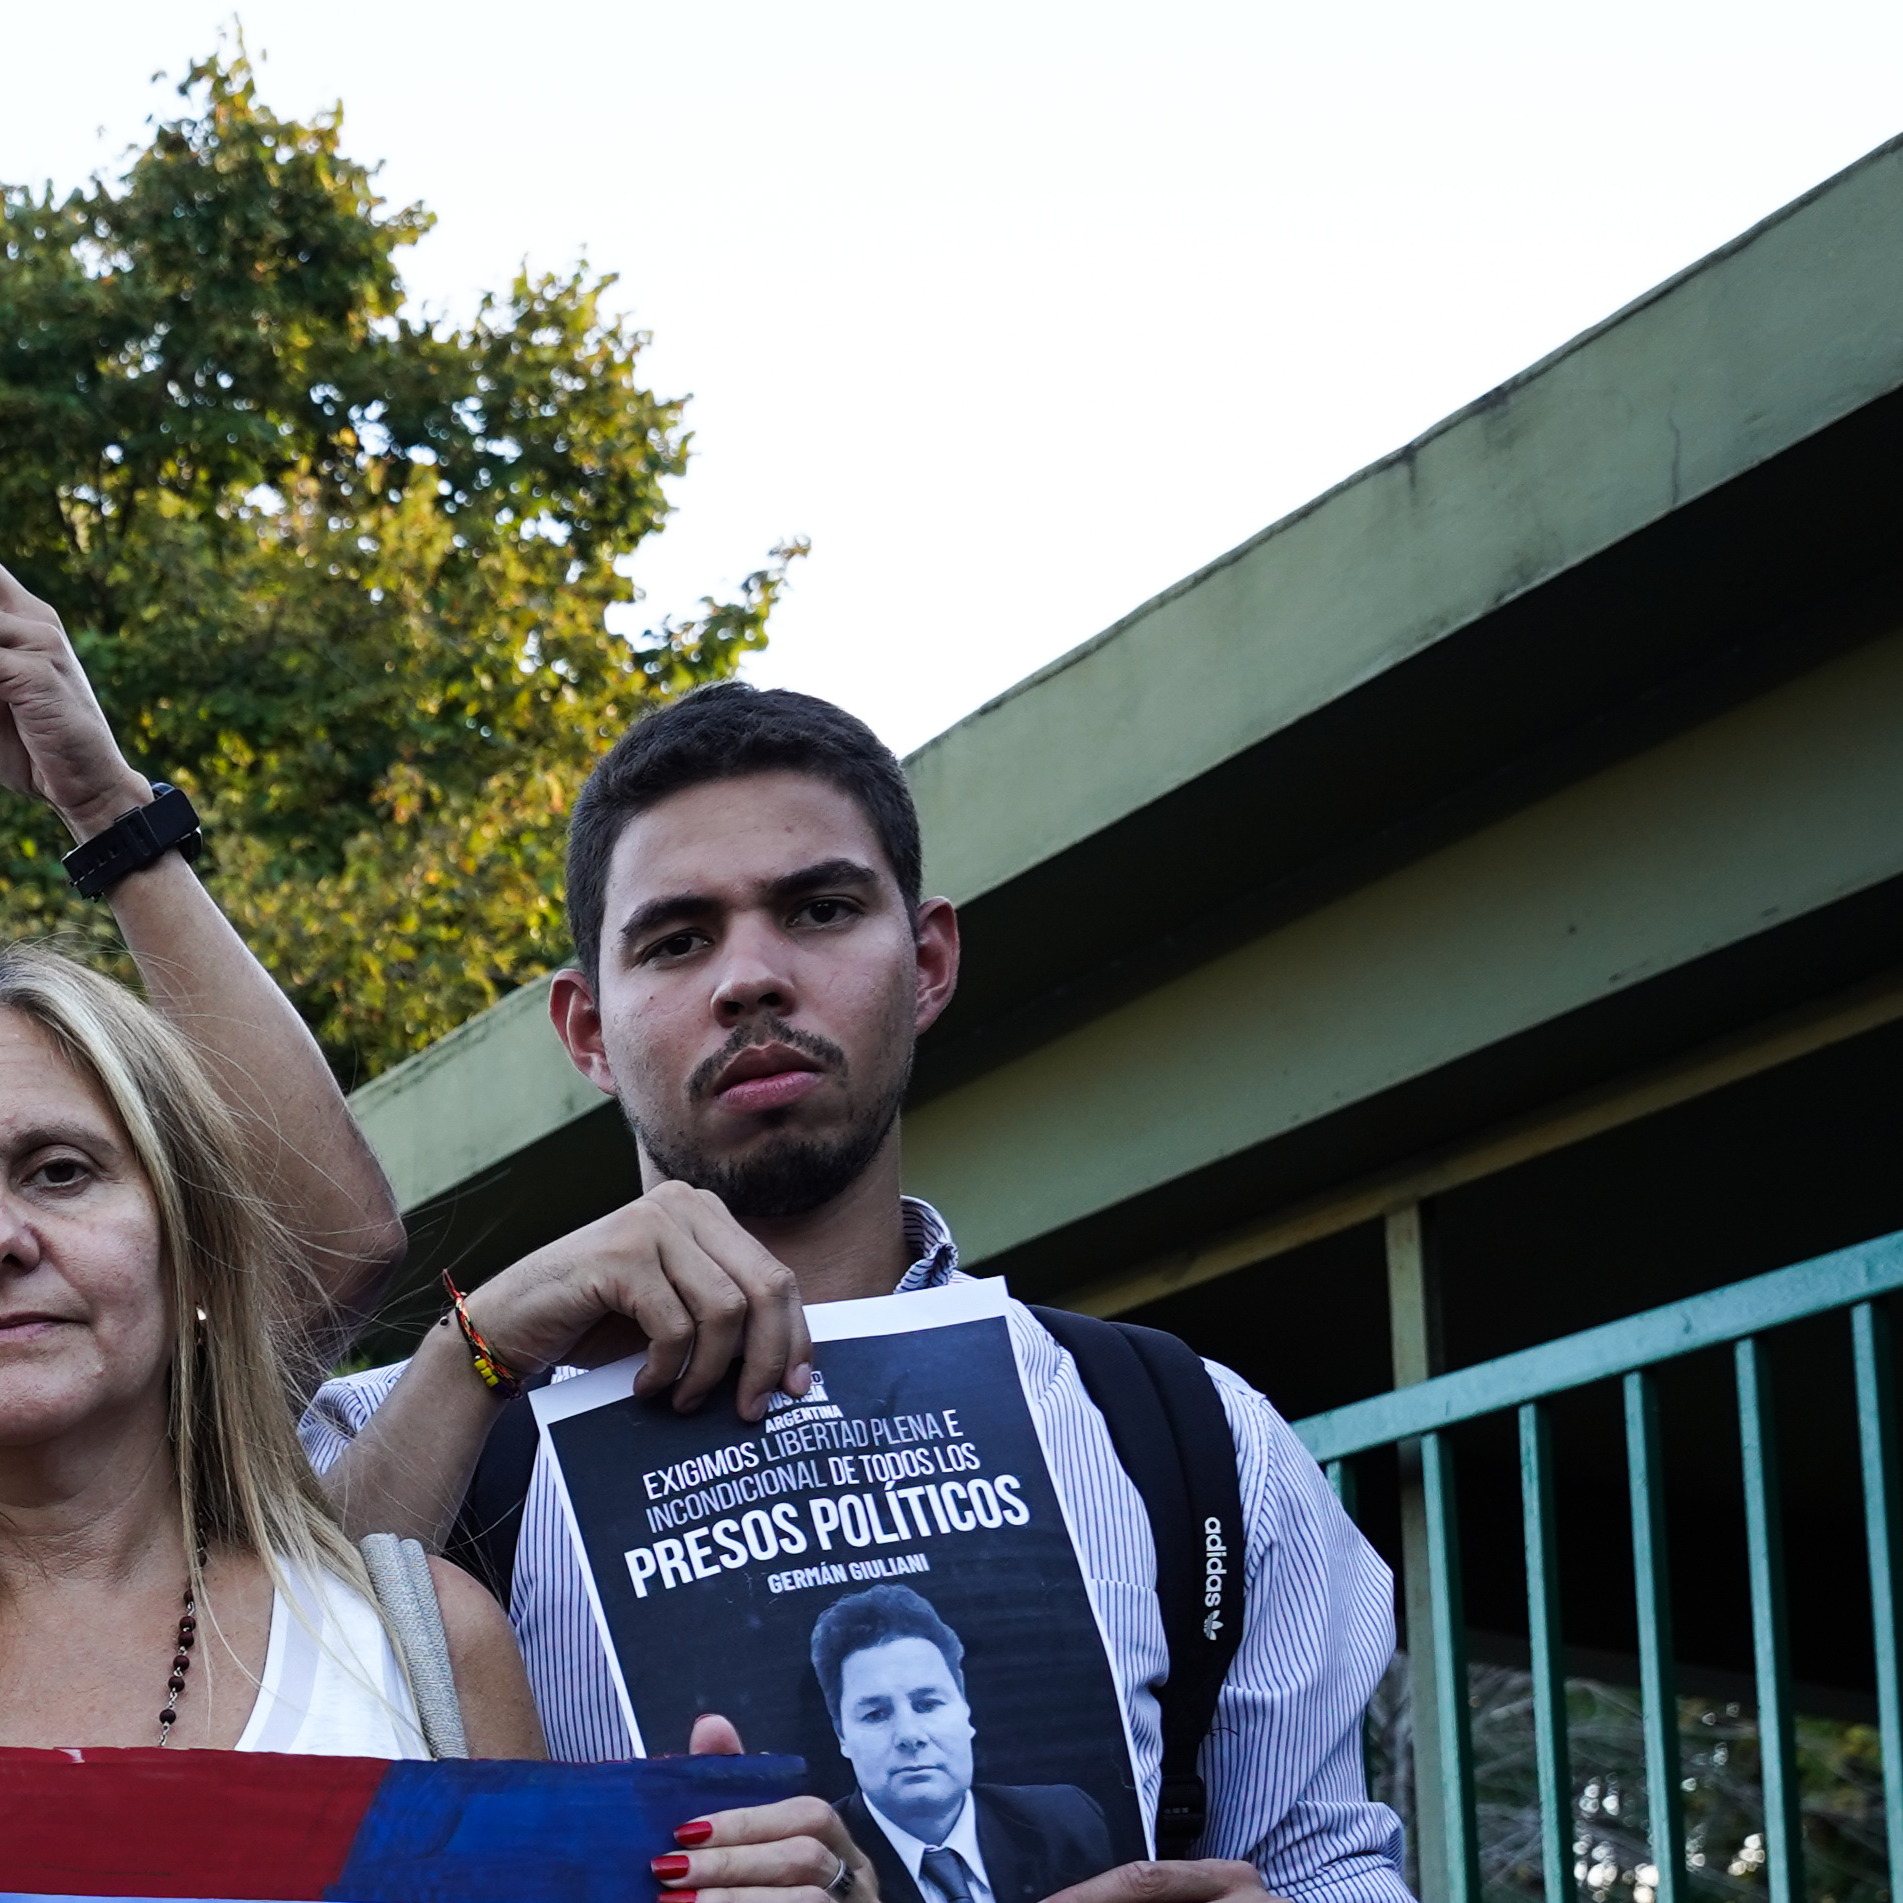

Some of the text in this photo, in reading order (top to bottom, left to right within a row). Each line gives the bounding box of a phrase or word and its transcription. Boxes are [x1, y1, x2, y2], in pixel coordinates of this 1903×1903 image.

[643, 1409, 964, 1500] EXIGIMOS LIBERTAD PLENA E
[766, 1405, 843, 1433] ARGENTINA
[645, 1442, 981, 1533] INCONDICIONAL DE TODOS LOS
[624, 1475, 1030, 1598] PRESOS POLÍTICOS
[767, 1553, 930, 1593] GERMÁN GIULIANI
[1204, 1517, 1227, 1607] adidas
